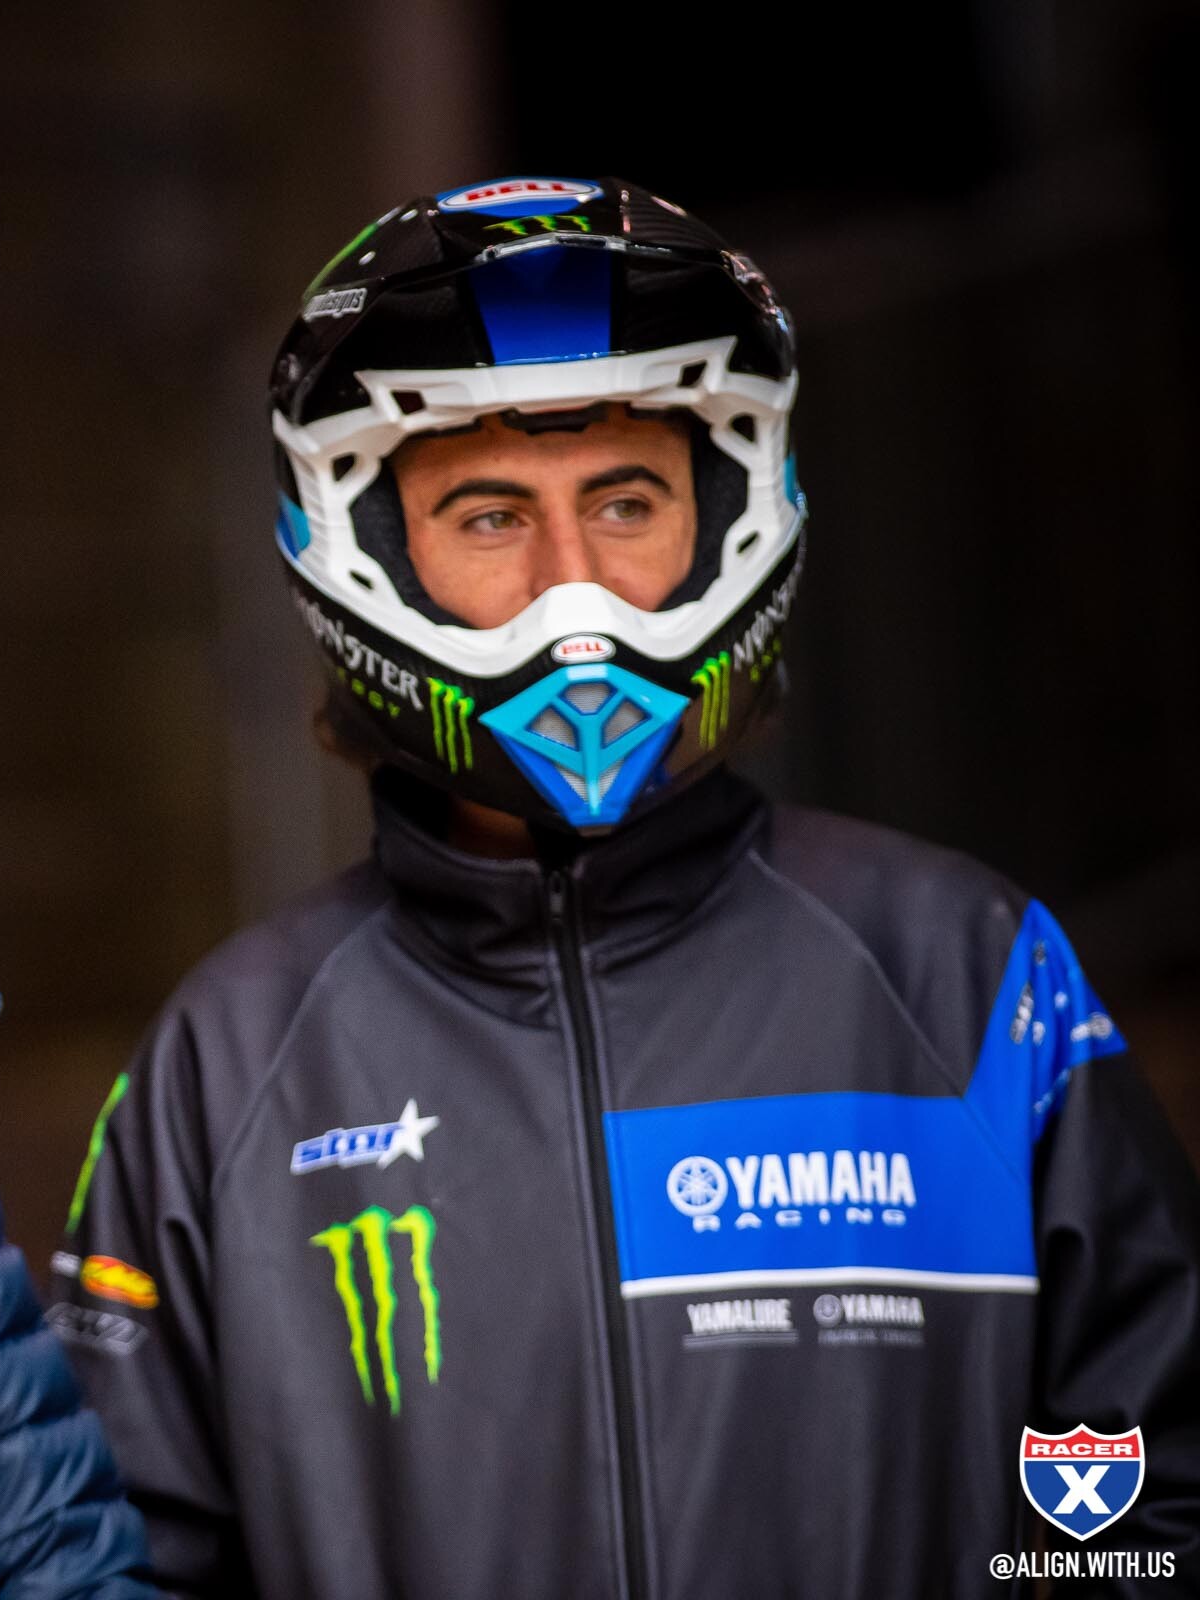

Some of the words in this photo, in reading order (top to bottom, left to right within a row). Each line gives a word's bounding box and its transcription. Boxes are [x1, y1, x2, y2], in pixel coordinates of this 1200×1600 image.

[465, 182, 576, 202] BELL
[725, 1150, 917, 1209] YAMAHA
[692, 1206, 907, 1234] RACING
